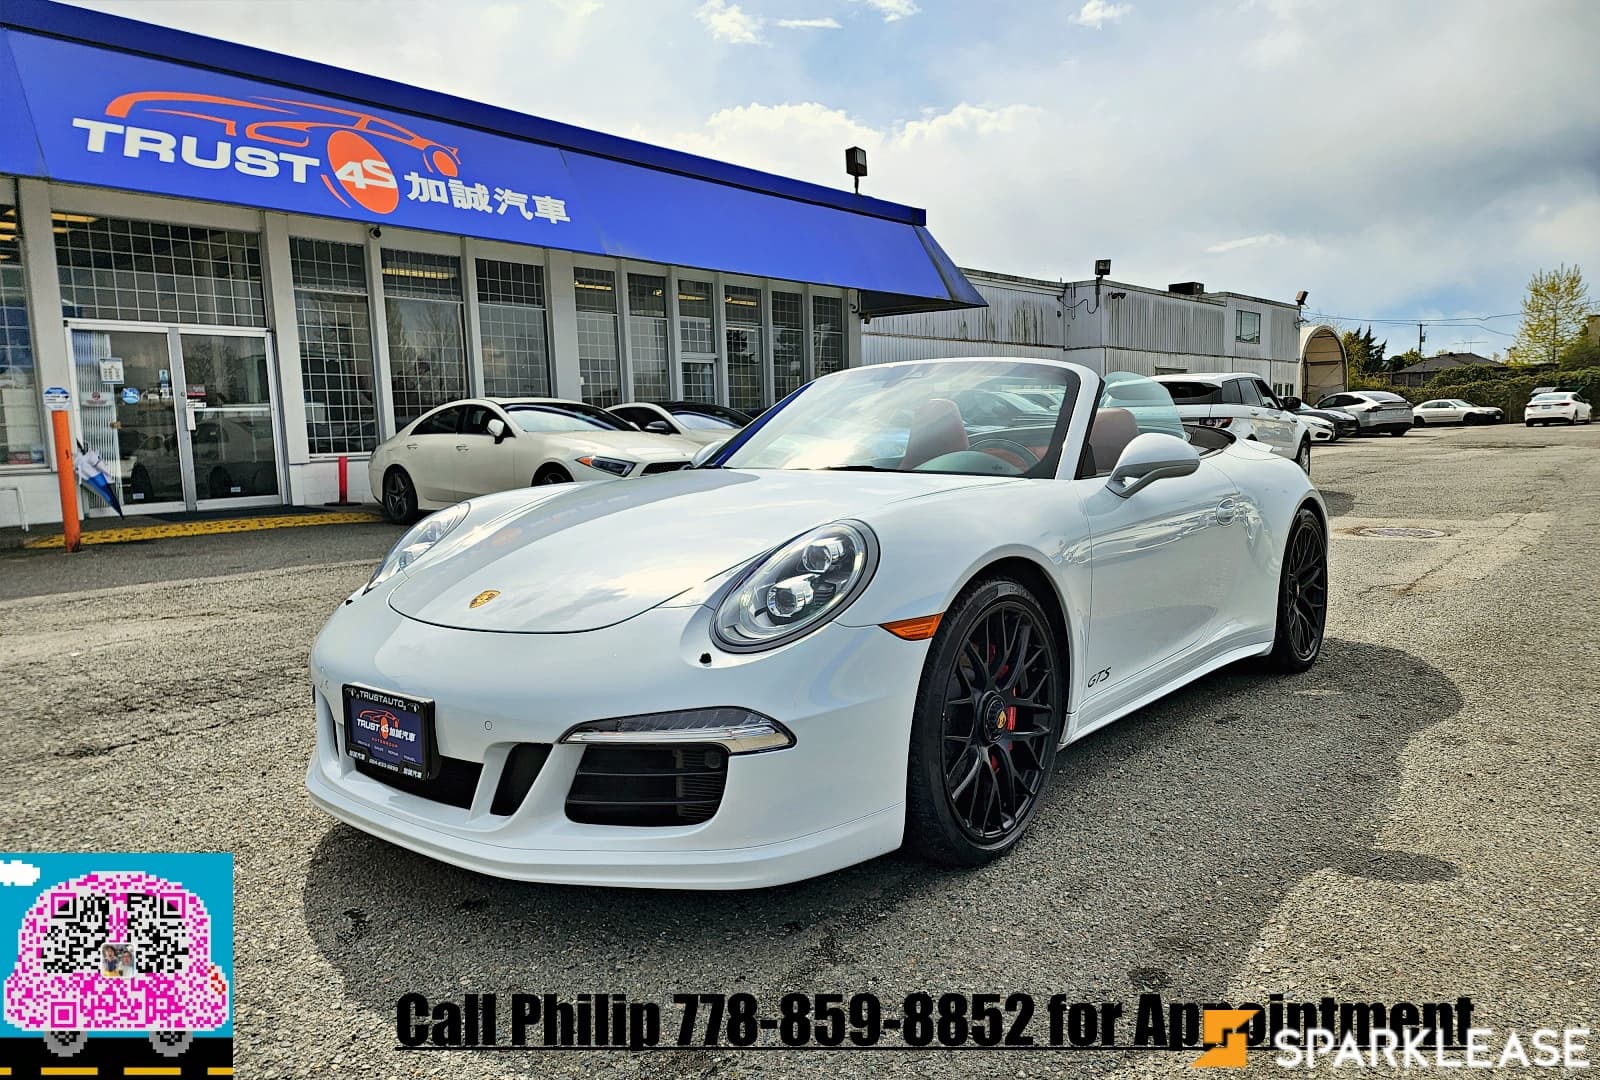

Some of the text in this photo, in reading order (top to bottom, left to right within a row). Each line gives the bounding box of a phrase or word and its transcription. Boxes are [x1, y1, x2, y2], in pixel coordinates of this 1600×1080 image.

[72, 117, 571, 224] TRUST 4S 加誠汽車
[1087, 666, 1111, 688] GTS
[359, 690, 404, 708] TRUSTAUTO
[356, 718, 380, 732] TRUST
